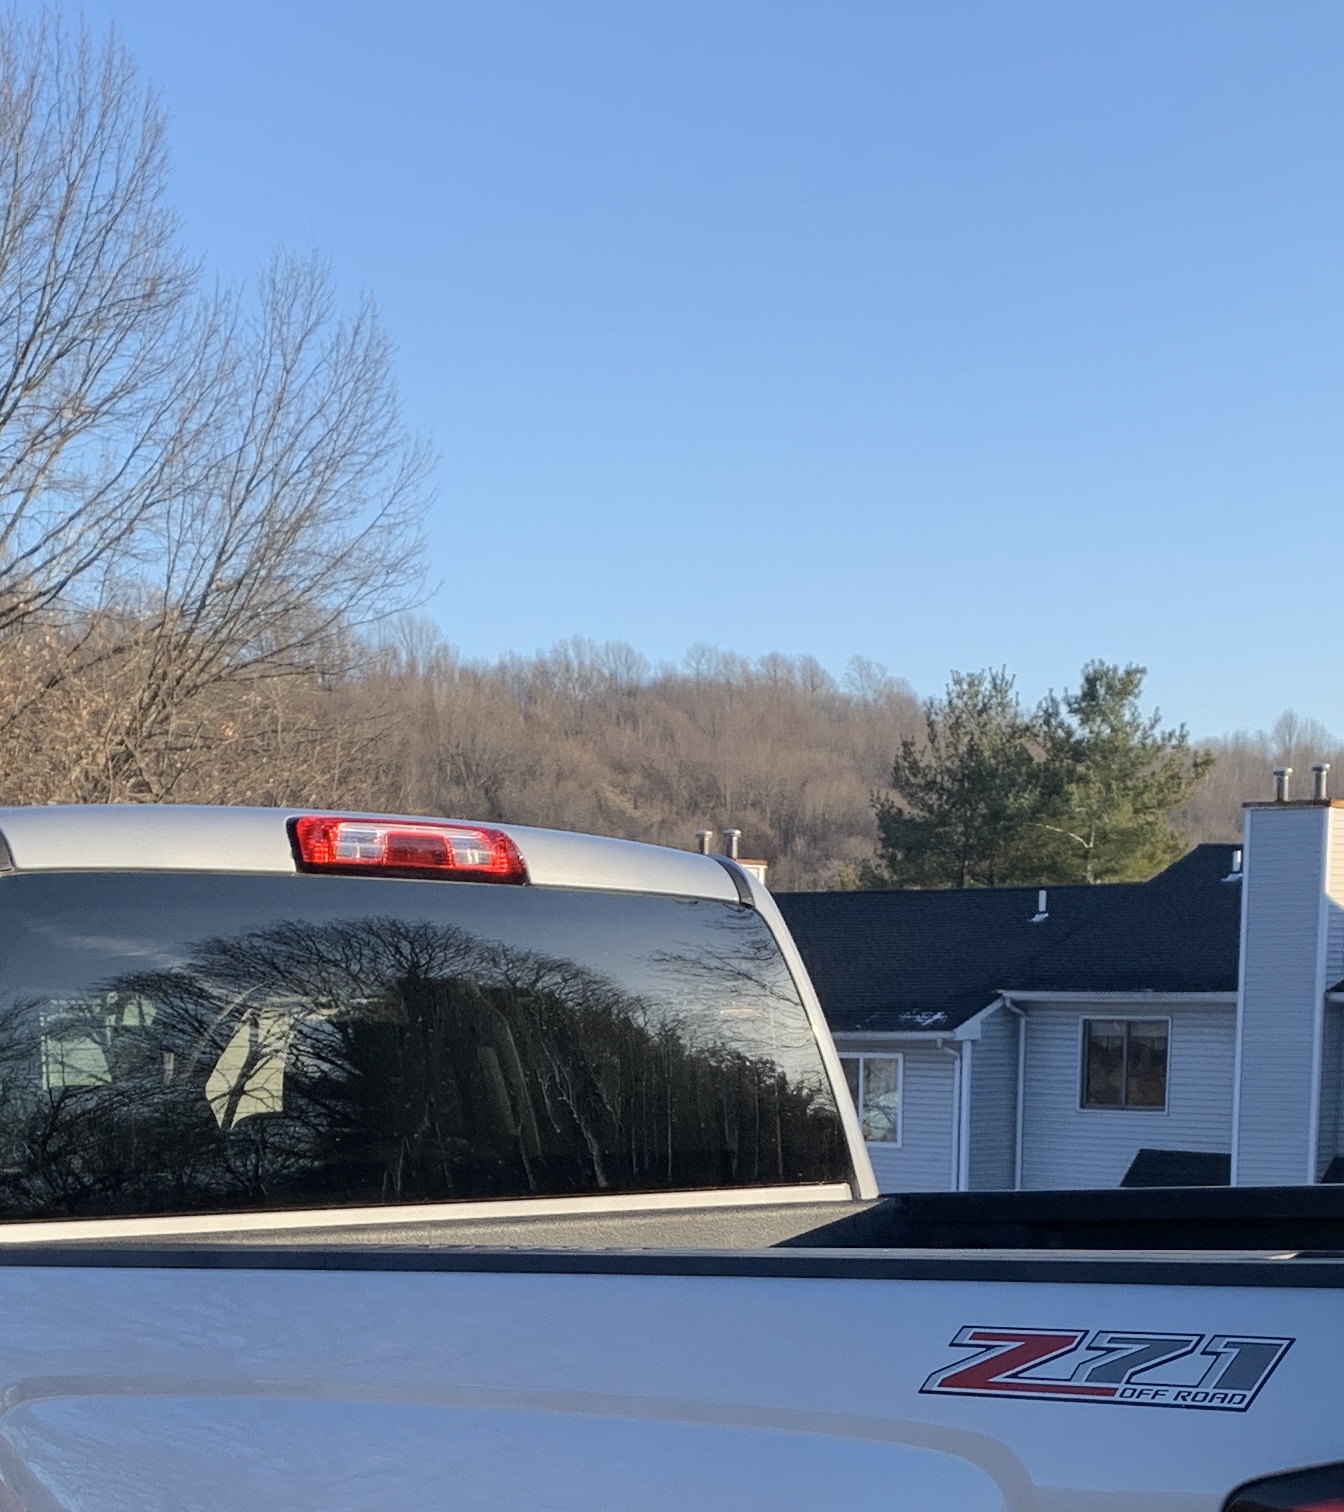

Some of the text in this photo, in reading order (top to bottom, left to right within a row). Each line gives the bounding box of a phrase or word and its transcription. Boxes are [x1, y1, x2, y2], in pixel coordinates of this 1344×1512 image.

[918, 1324, 1296, 1412] Z71
[1118, 1386, 1248, 1406] OFF ROAD
